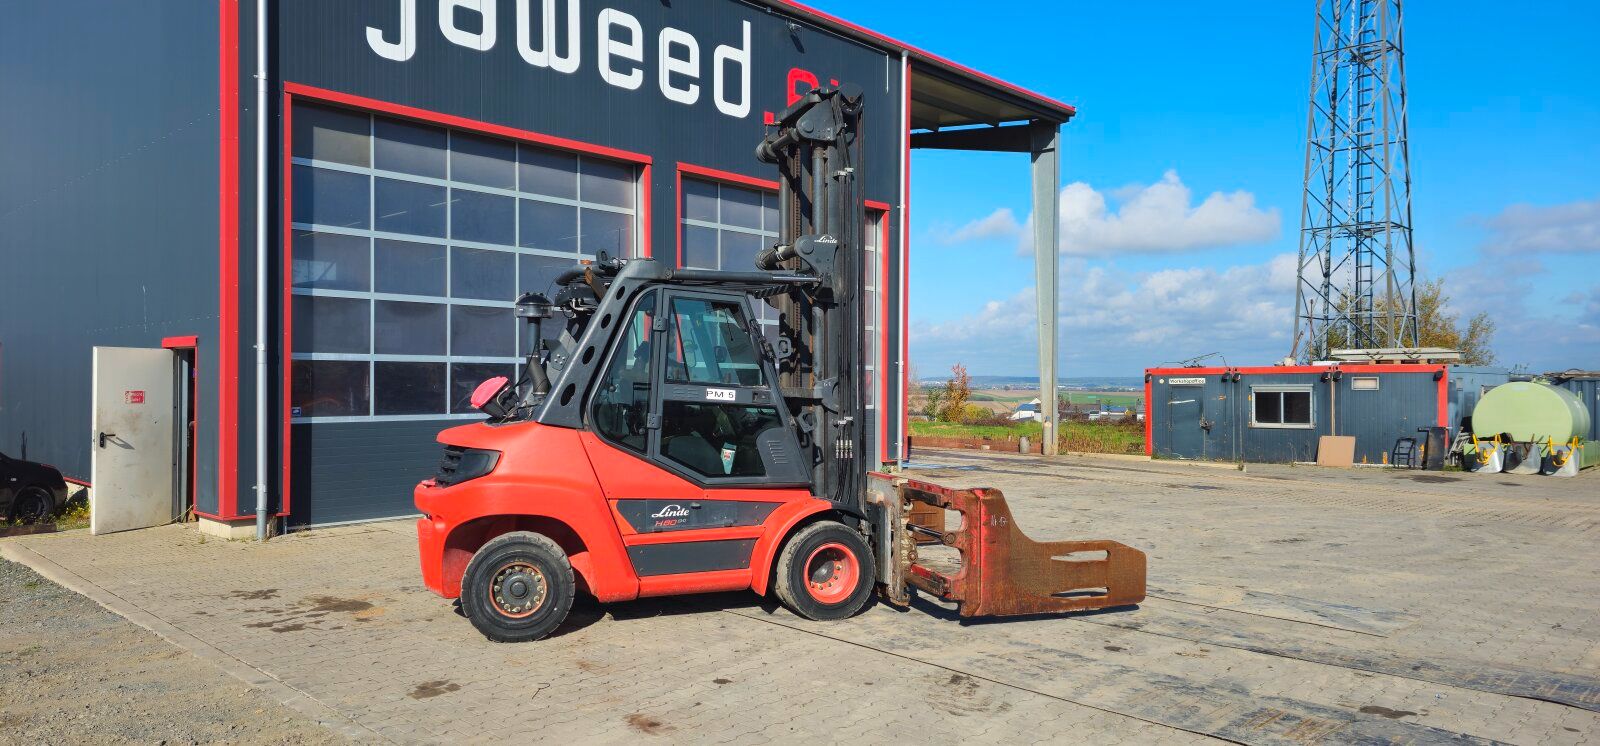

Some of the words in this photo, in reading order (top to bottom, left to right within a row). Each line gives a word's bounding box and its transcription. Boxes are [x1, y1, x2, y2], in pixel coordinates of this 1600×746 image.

[706, 390, 724, 398] PM
[728, 391, 734, 399] 5
[651, 504, 690, 518] Linde
